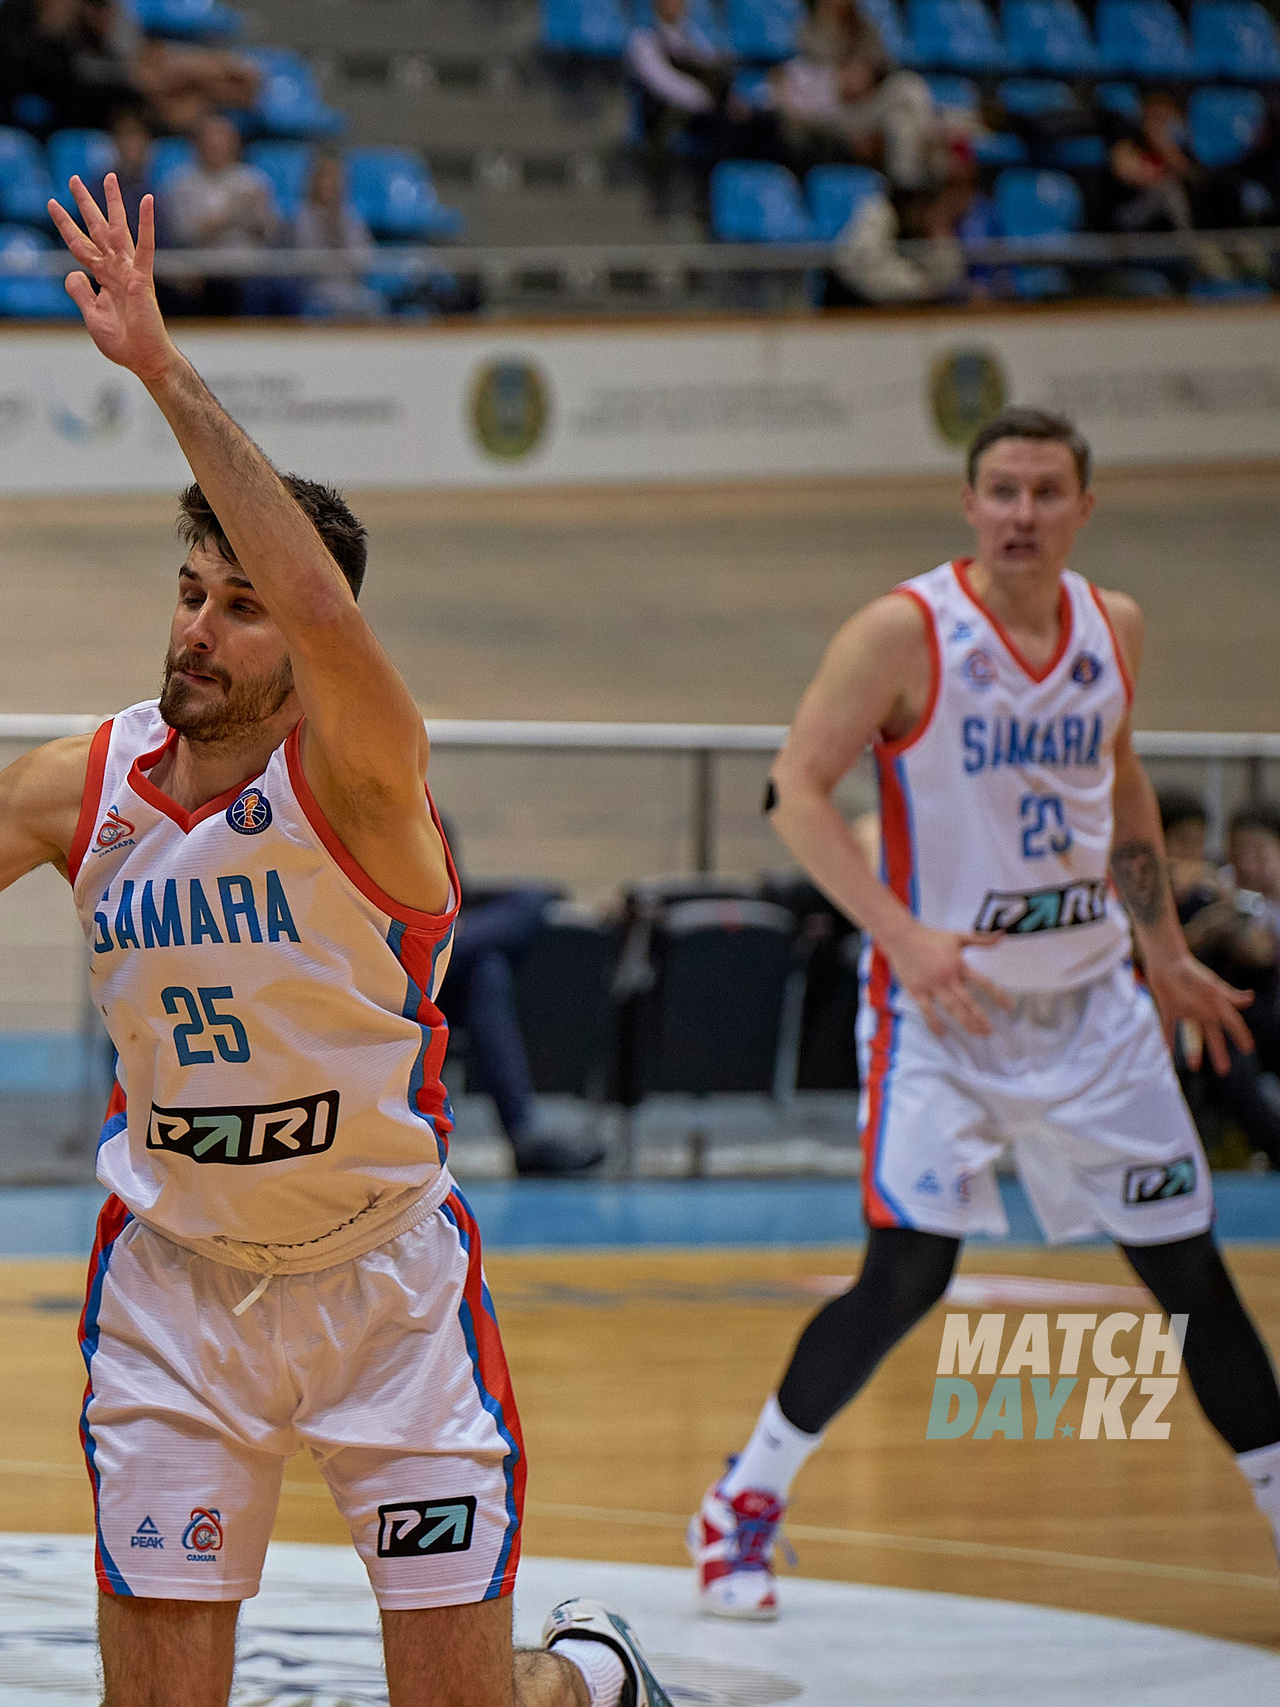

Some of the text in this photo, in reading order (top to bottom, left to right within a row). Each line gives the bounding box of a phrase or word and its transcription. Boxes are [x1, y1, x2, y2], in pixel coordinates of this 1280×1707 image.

[962, 710, 1103, 775] SAMARA
[94, 869, 301, 954] SAMARA
[161, 985, 251, 1067] 25
[150, 1100, 330, 1157] PARI
[131, 1536, 165, 1548] PEAK
